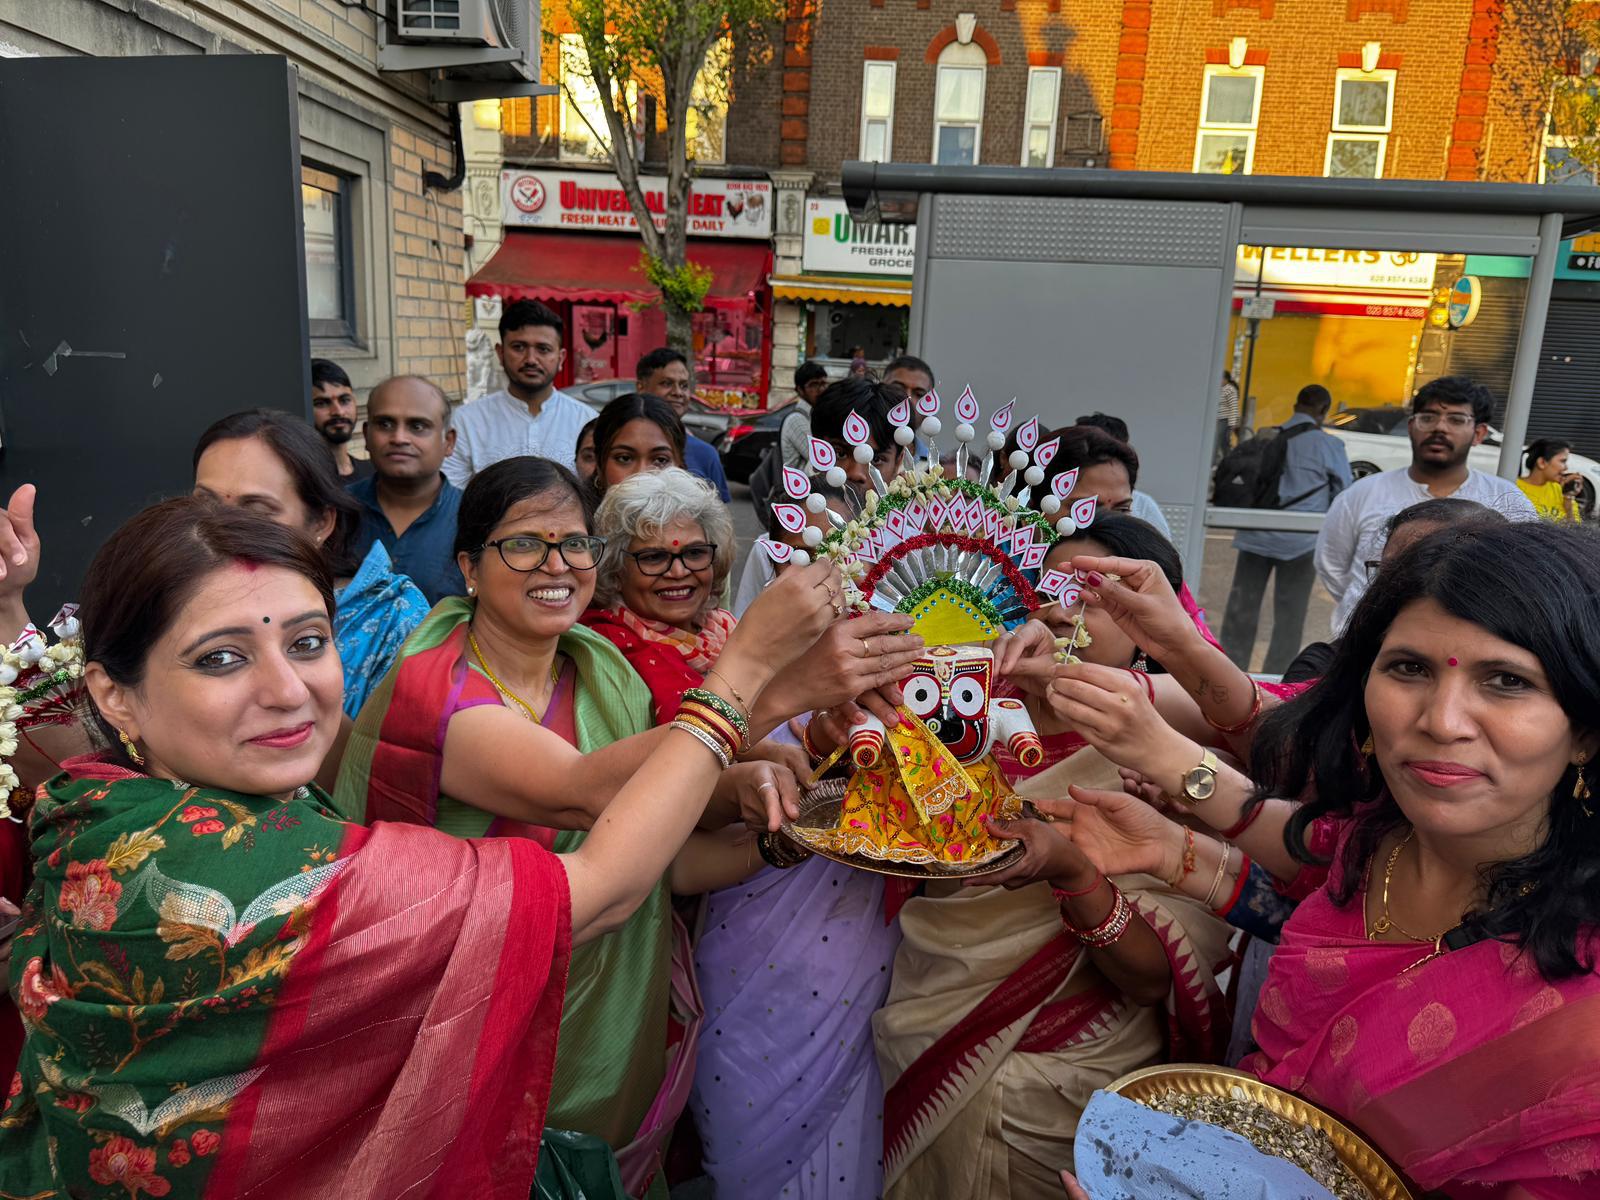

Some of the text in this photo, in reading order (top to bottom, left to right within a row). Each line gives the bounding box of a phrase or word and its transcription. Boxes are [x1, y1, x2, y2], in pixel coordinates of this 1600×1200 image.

[561, 213, 594, 224] FRESH
[598, 215, 626, 225] MEAT
[693, 220, 725, 231] DAILY
[851, 246, 893, 257] FRESH
